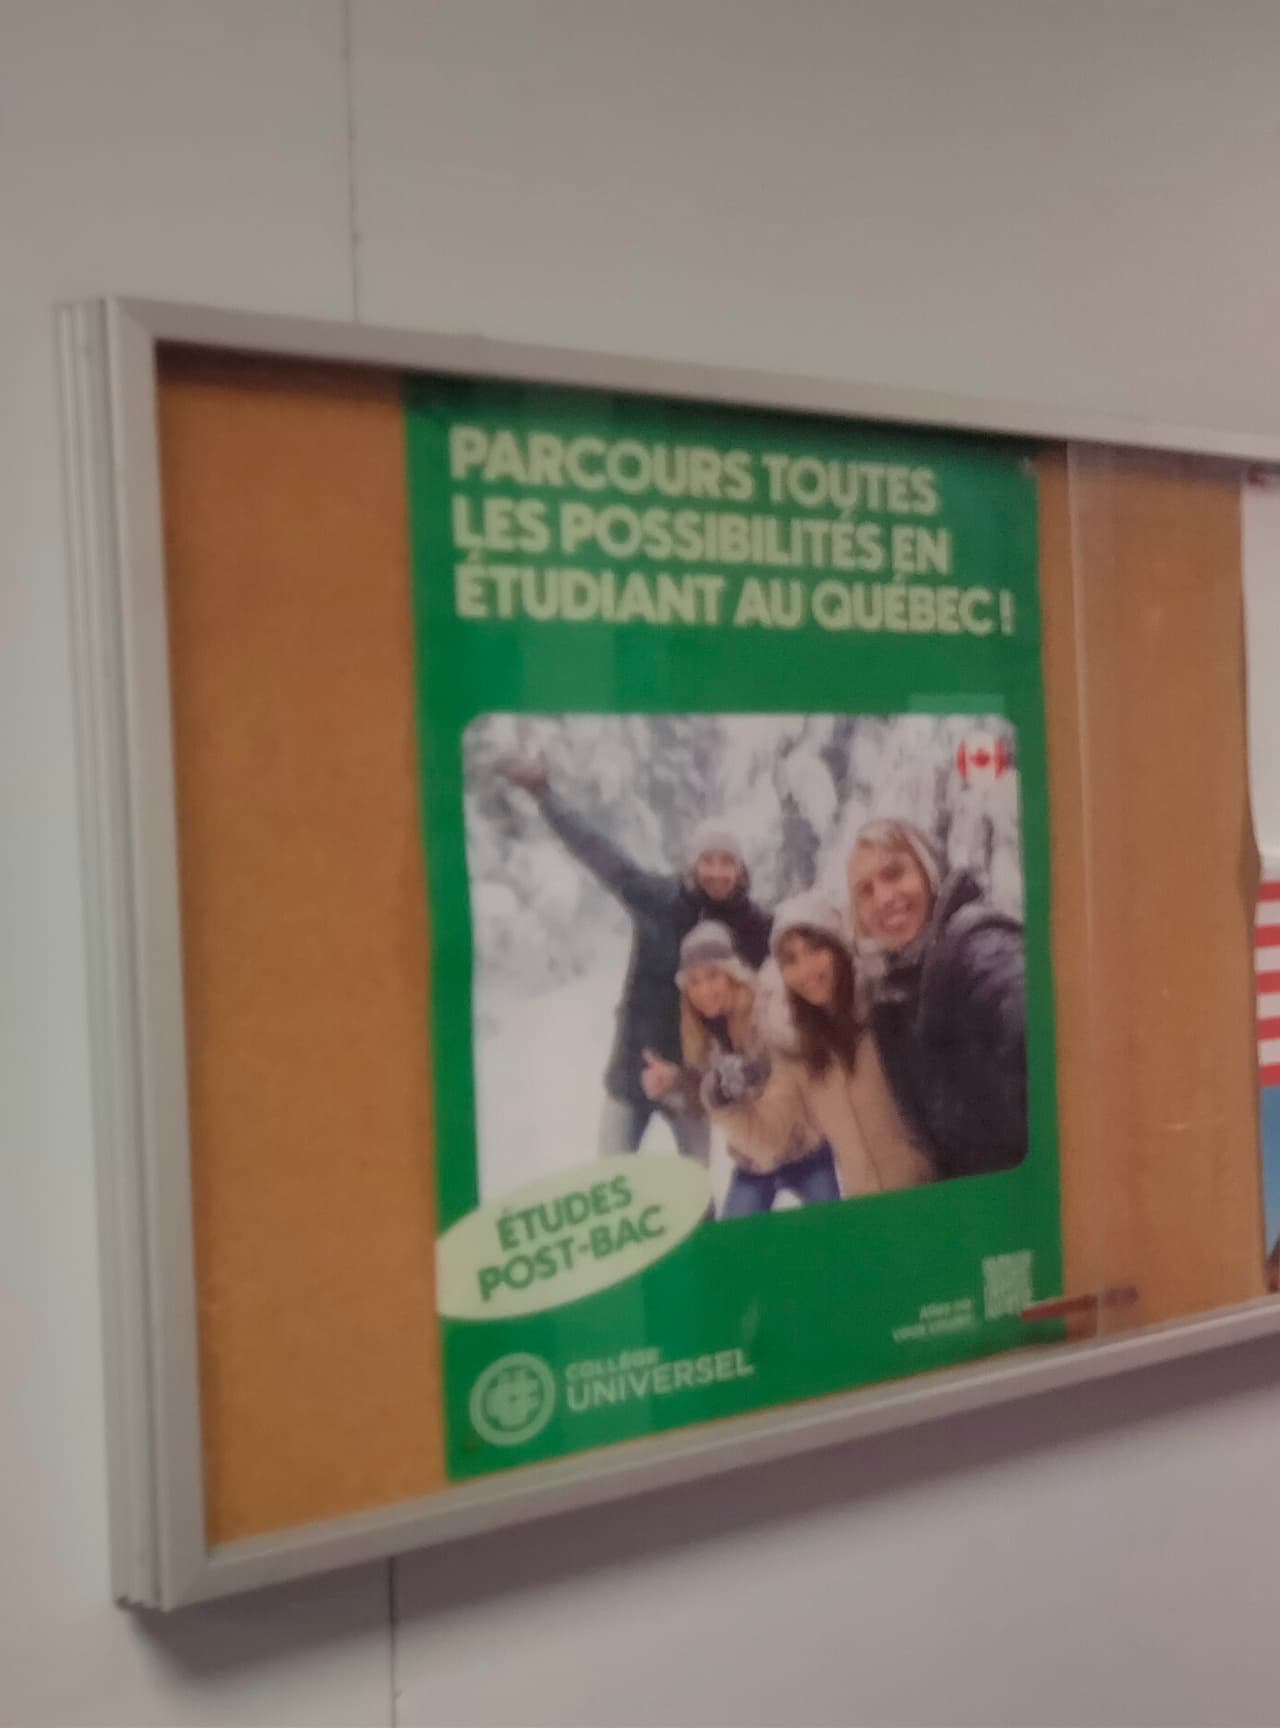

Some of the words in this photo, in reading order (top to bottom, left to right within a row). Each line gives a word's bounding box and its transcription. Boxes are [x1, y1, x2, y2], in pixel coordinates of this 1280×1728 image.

[449, 424, 756, 500] PARCOURS
[762, 452, 940, 516] TOUTES
[452, 495, 551, 554] LES
[560, 503, 885, 572] POSSIBILITÉS
[892, 524, 951, 575] EN
[454, 548, 725, 624] ÉTUDIANT
[733, 578, 801, 628] AU
[811, 571, 994, 635] QUÉBEC
[477, 1204, 666, 1304] POST-BAC
[496, 1174, 633, 1251] ÉTUDES
[566, 1348, 755, 1412] UNIVERSEL
